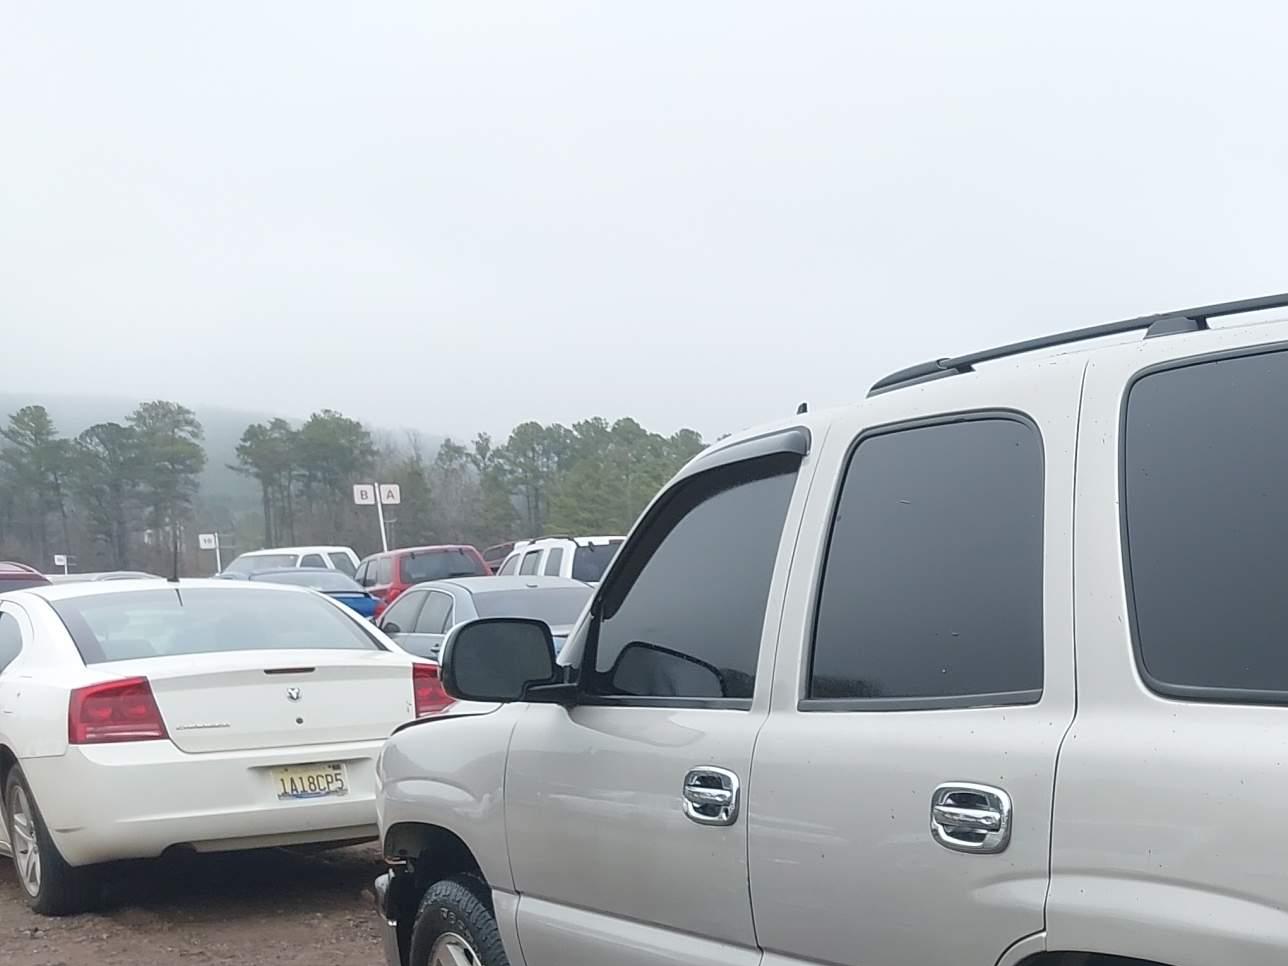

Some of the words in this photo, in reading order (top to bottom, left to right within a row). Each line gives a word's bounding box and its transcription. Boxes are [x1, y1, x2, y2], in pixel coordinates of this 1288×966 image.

[360, 490, 369, 500] B
[386, 489, 395, 500] A
[281, 772, 344, 794] 1A18CP5
